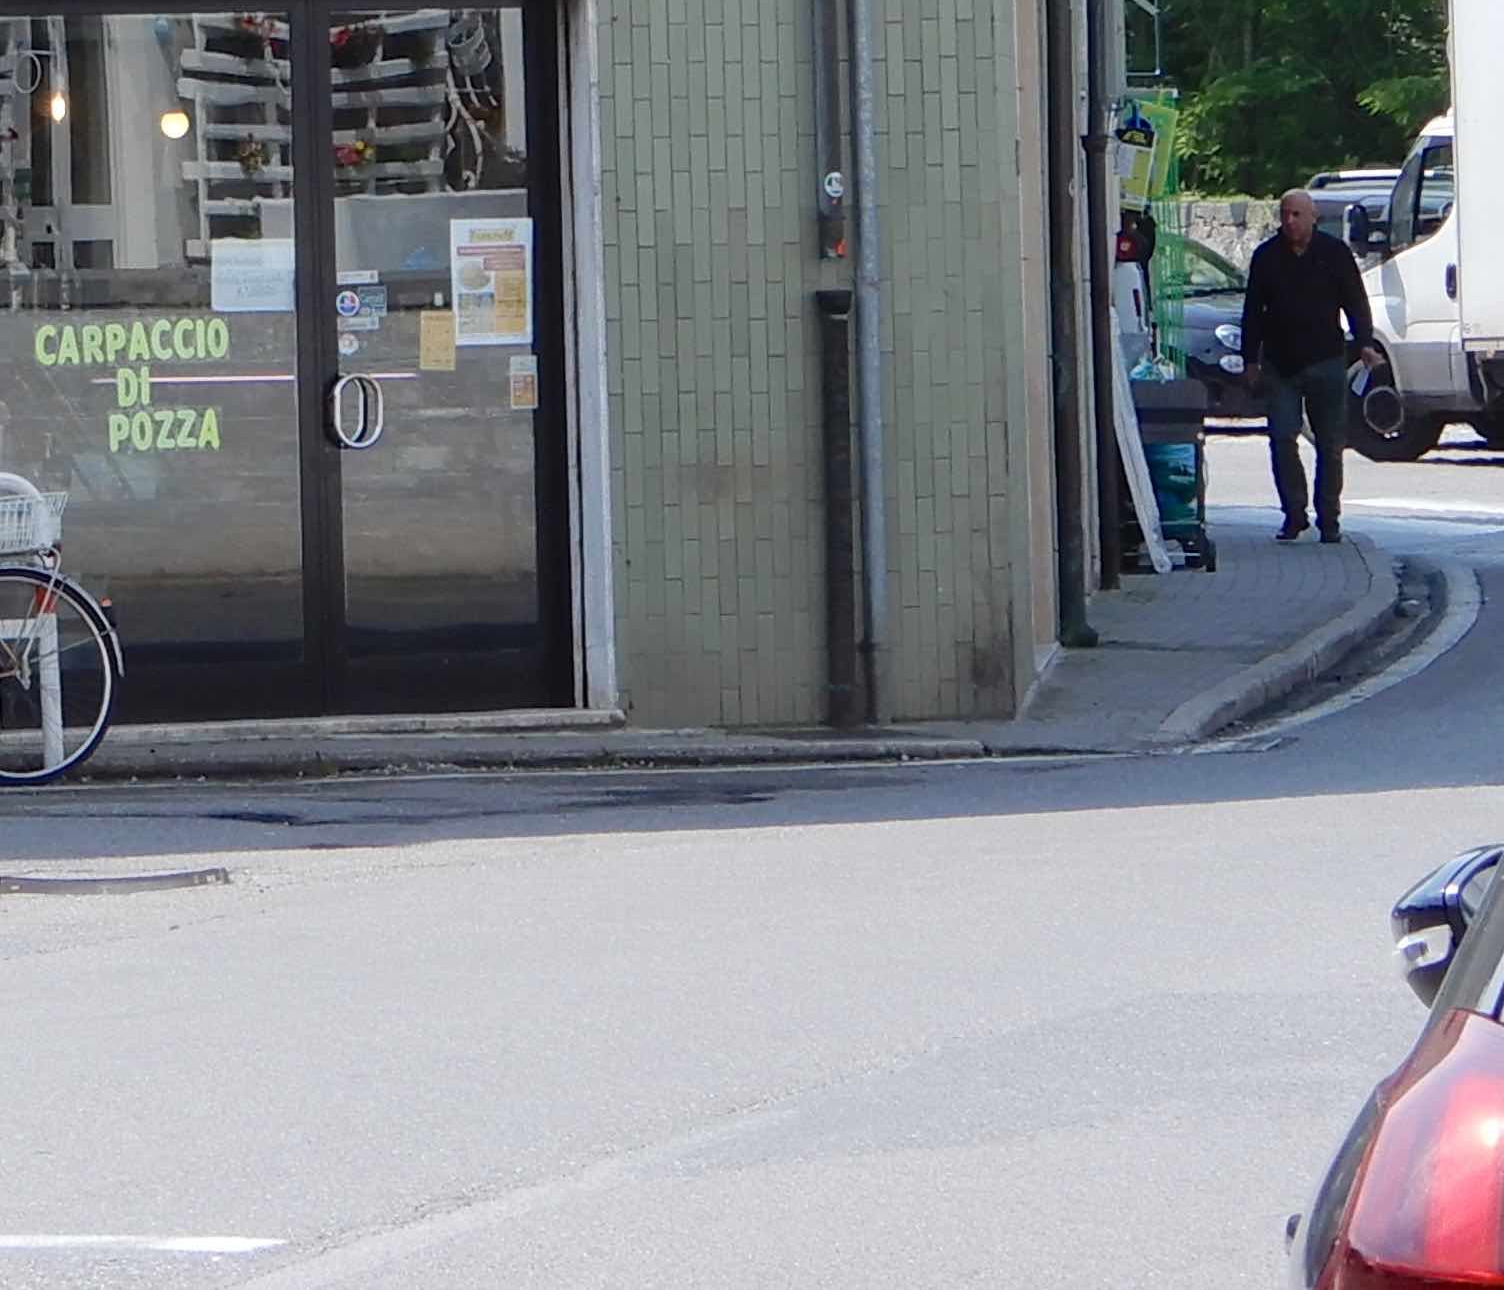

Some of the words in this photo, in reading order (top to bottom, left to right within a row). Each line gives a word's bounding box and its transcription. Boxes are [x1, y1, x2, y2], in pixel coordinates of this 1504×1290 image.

[35, 318, 229, 366] CARPACCIO
[116, 366, 151, 408] DI
[108, 408, 221, 453] POZZA
